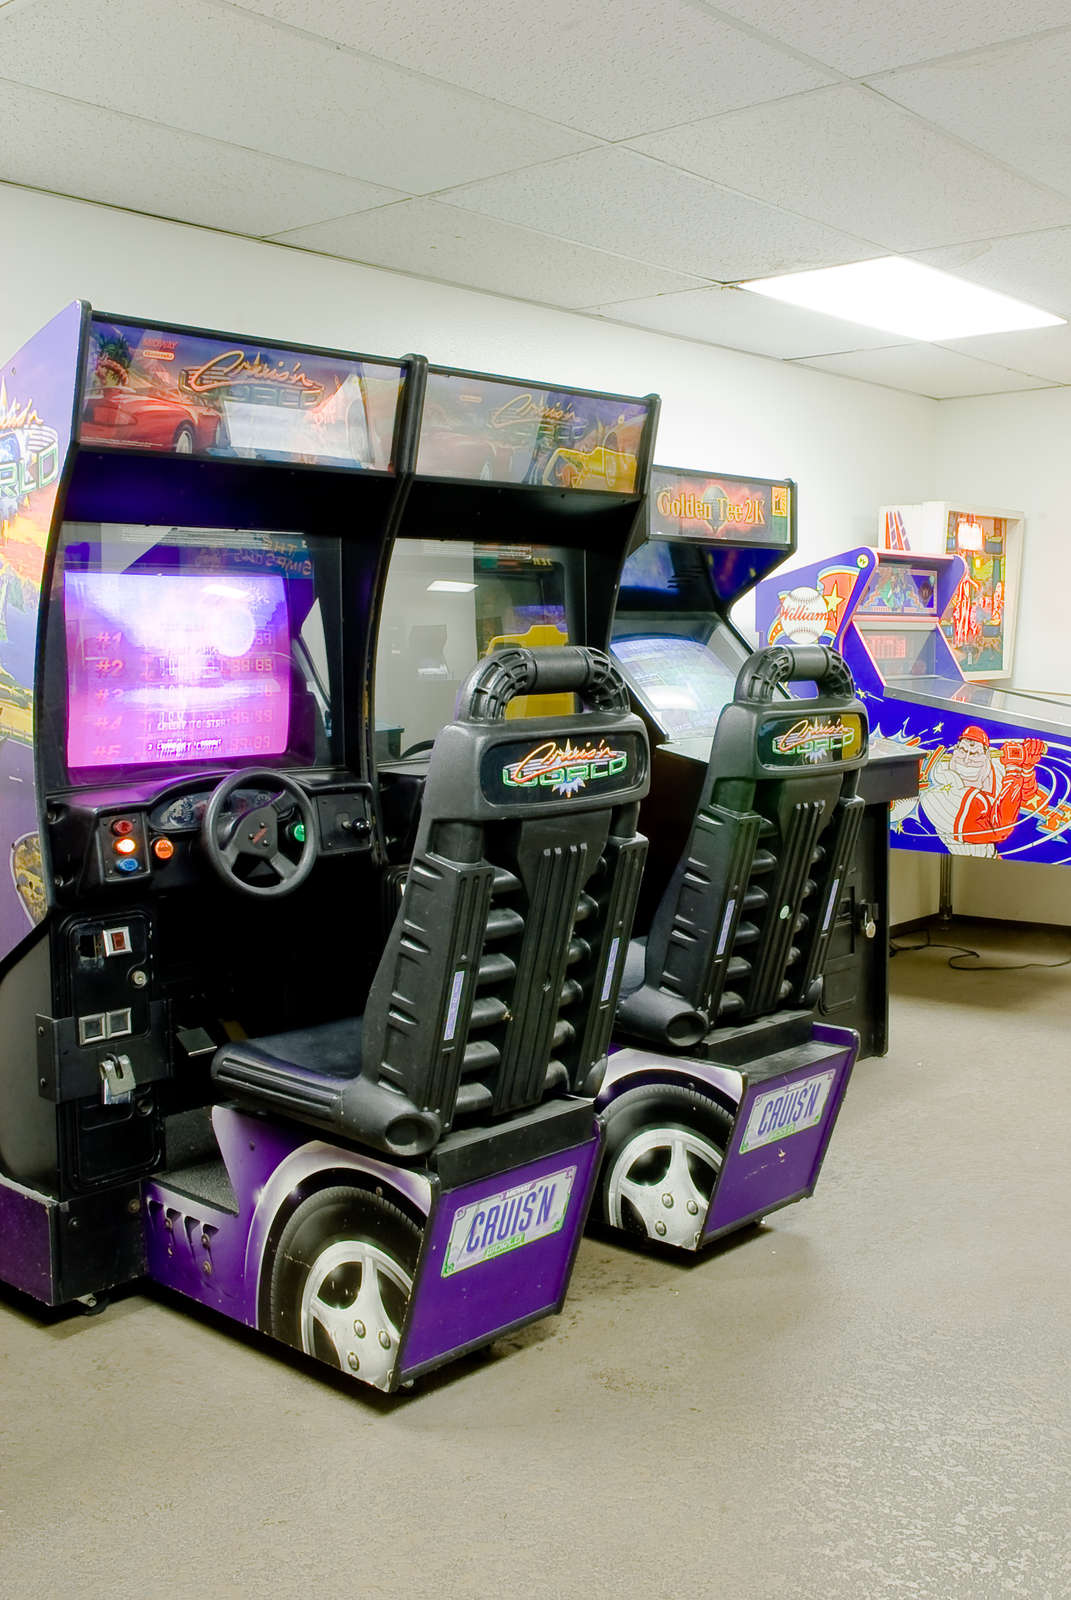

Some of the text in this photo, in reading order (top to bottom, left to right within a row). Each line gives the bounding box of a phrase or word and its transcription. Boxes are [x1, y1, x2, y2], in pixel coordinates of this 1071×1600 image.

[0, 441, 59, 498] RLD
[656, 486, 712, 520] Golden
[502, 756, 628, 787] WORLD
[514, 739, 618, 784] Cruis'n
[757, 1082, 822, 1136] CRUIS'N
[466, 1183, 557, 1253] CRUIS'N
